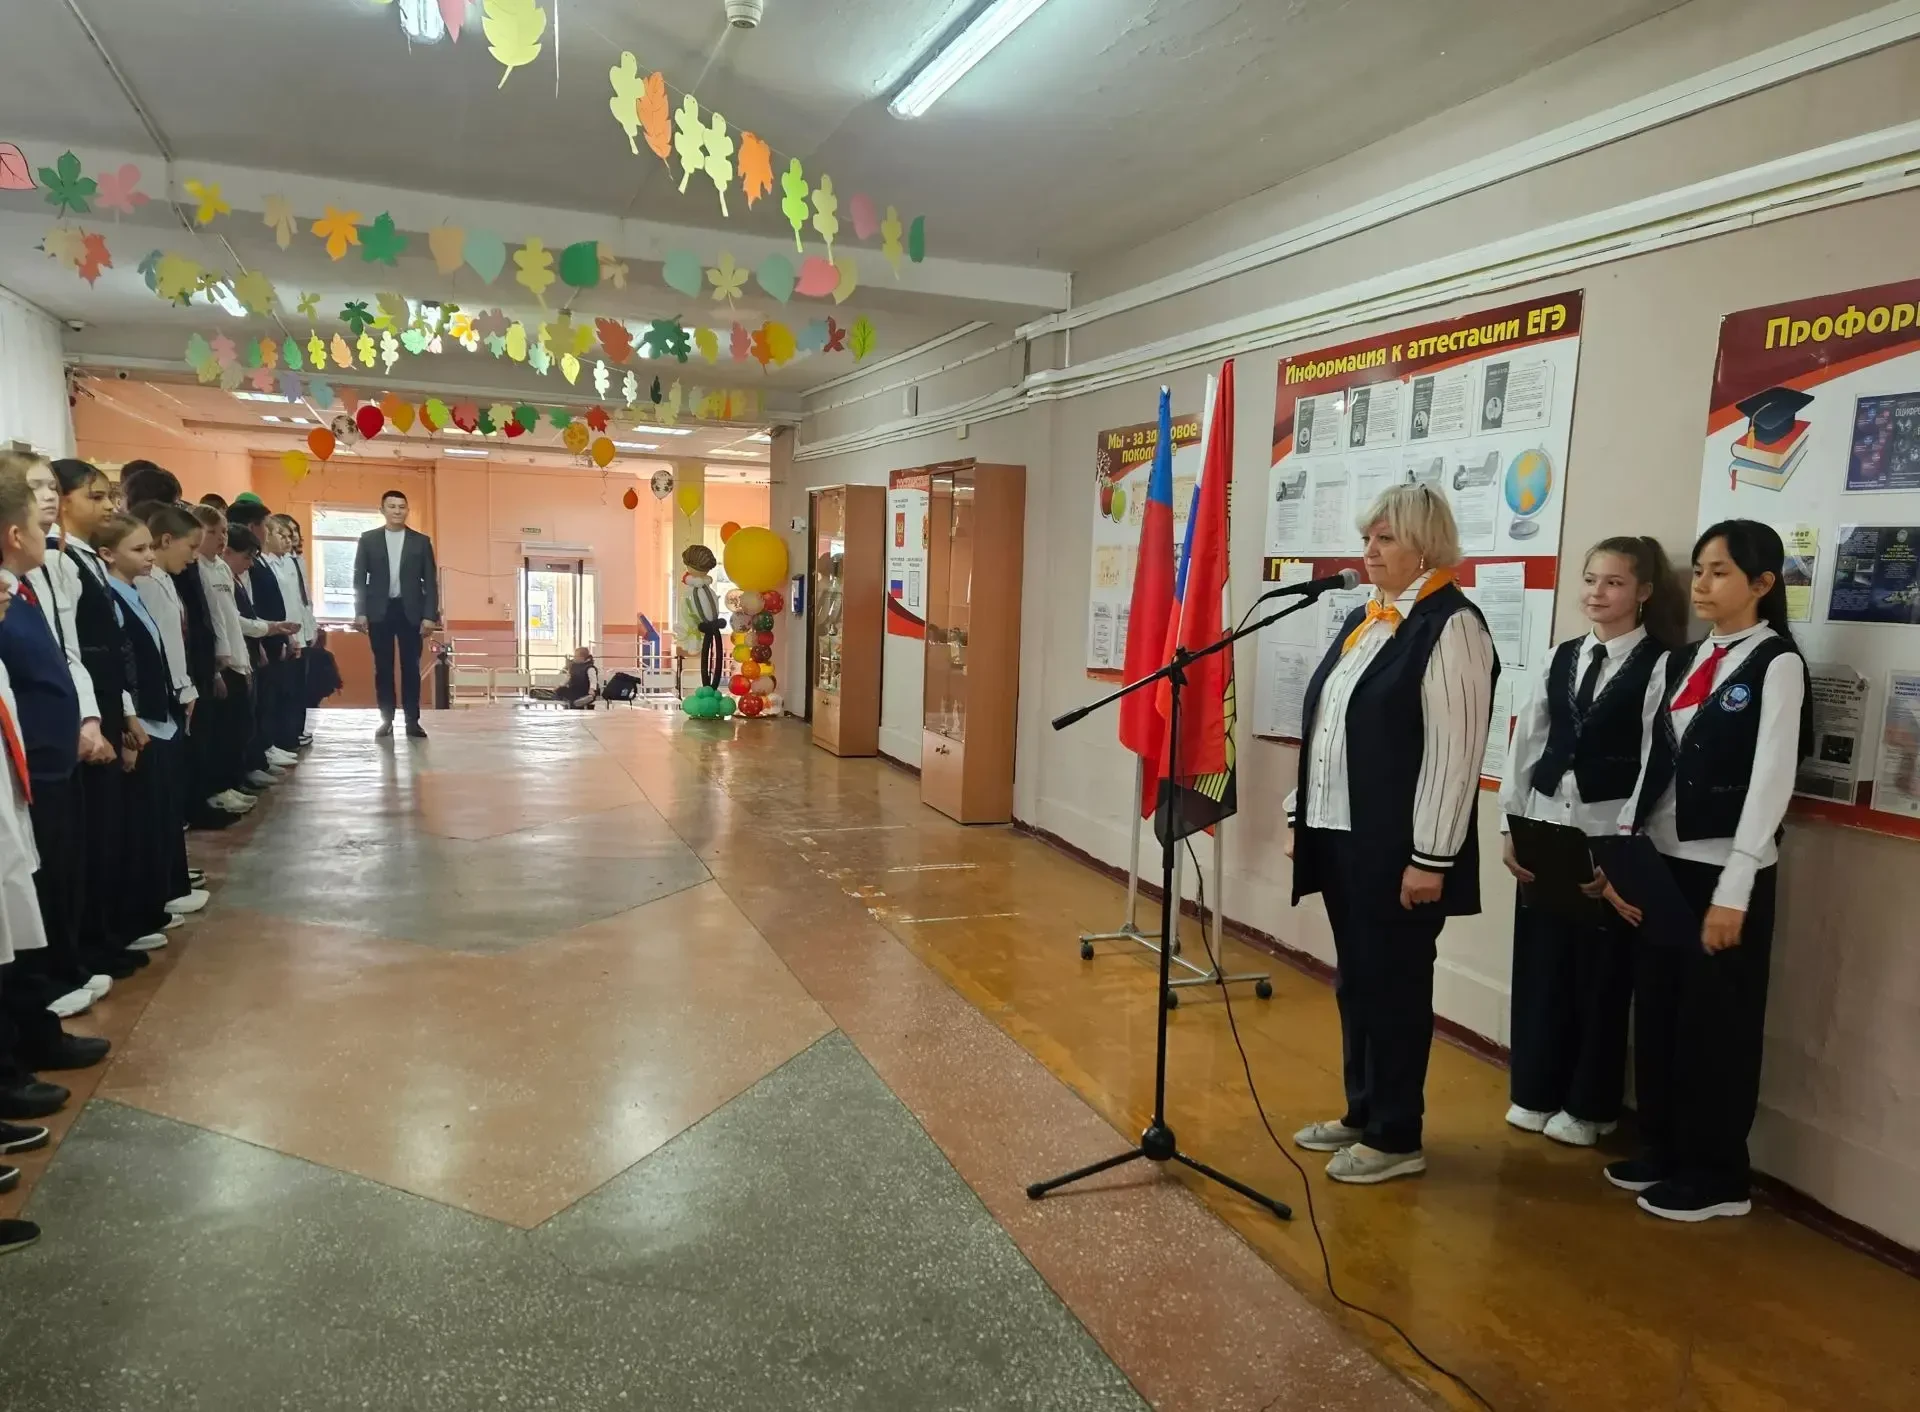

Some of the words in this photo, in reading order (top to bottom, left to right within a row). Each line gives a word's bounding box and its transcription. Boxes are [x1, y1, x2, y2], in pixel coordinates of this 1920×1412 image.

[1285, 348, 1387, 385] Информация
[1392, 344, 1402, 363] к
[1407, 317, 1521, 360] аттестации
[1527, 303, 1567, 336] ЕГЭ
[1108, 433, 1124, 450] Мы
[1132, 431, 1144, 446] за
[1145, 422, 1198, 444] здовое
